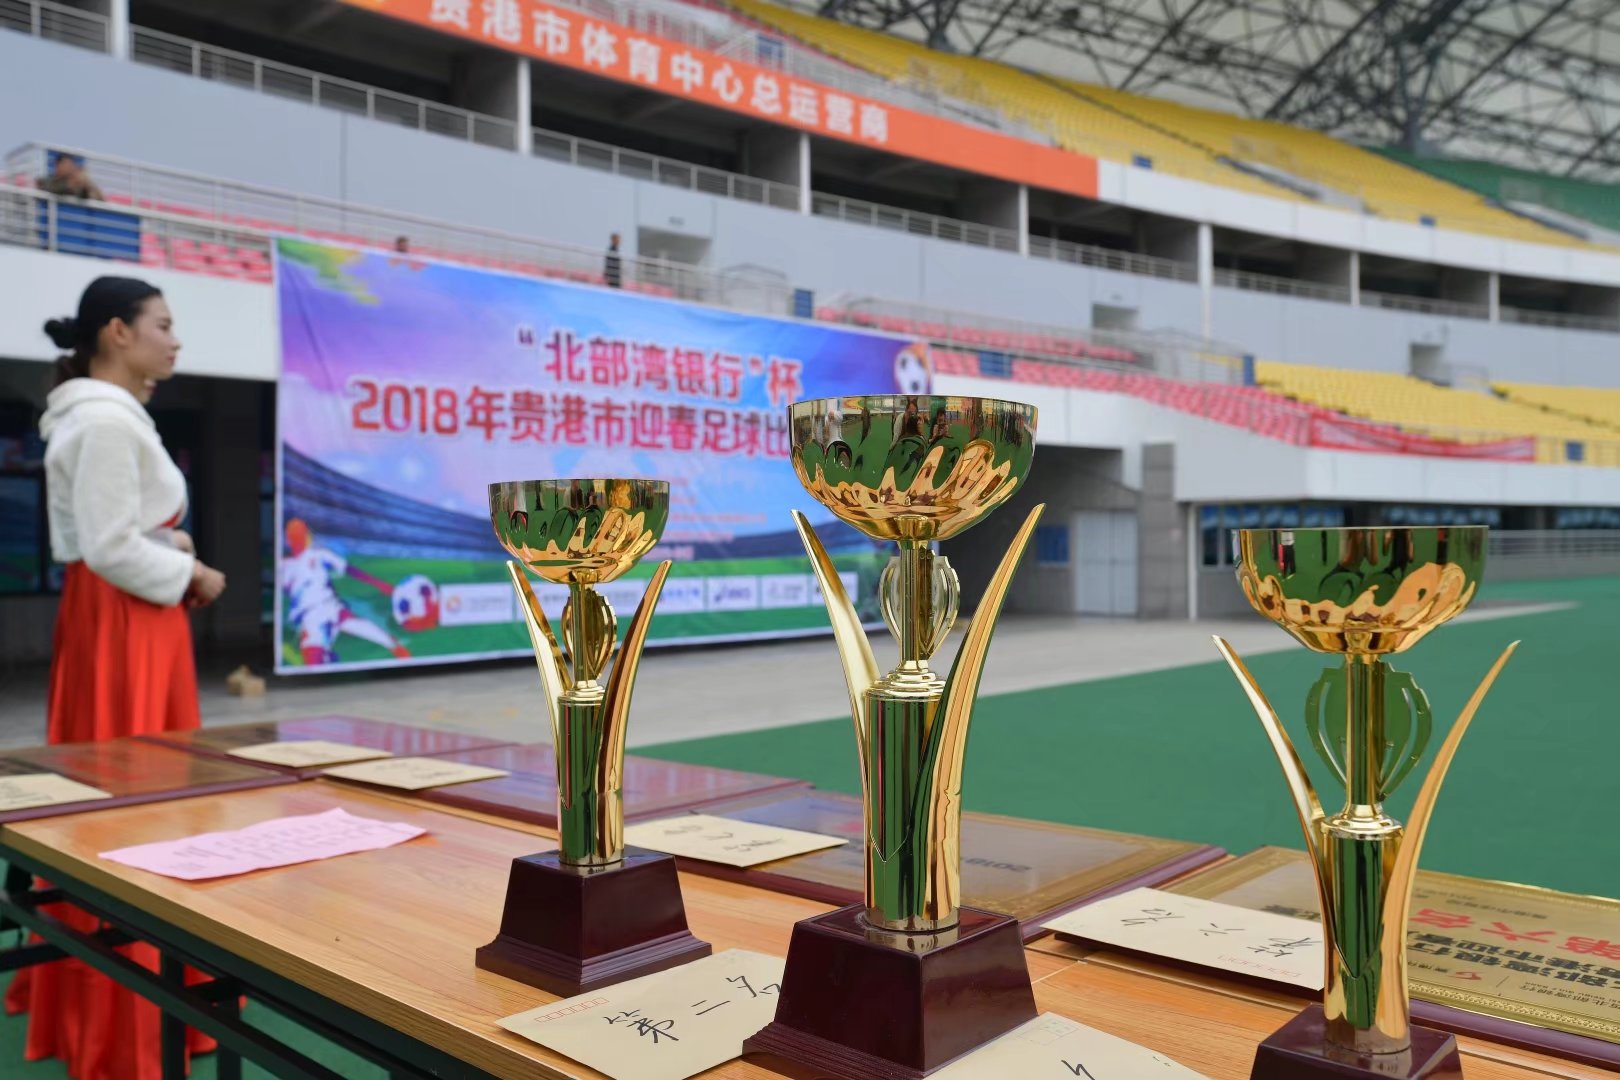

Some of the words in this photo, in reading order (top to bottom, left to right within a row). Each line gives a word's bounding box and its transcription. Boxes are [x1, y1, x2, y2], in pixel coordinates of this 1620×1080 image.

[518, 327, 804, 407] “北部湾银行”杯
[1407, 941, 1620, 989] 部湾银行
